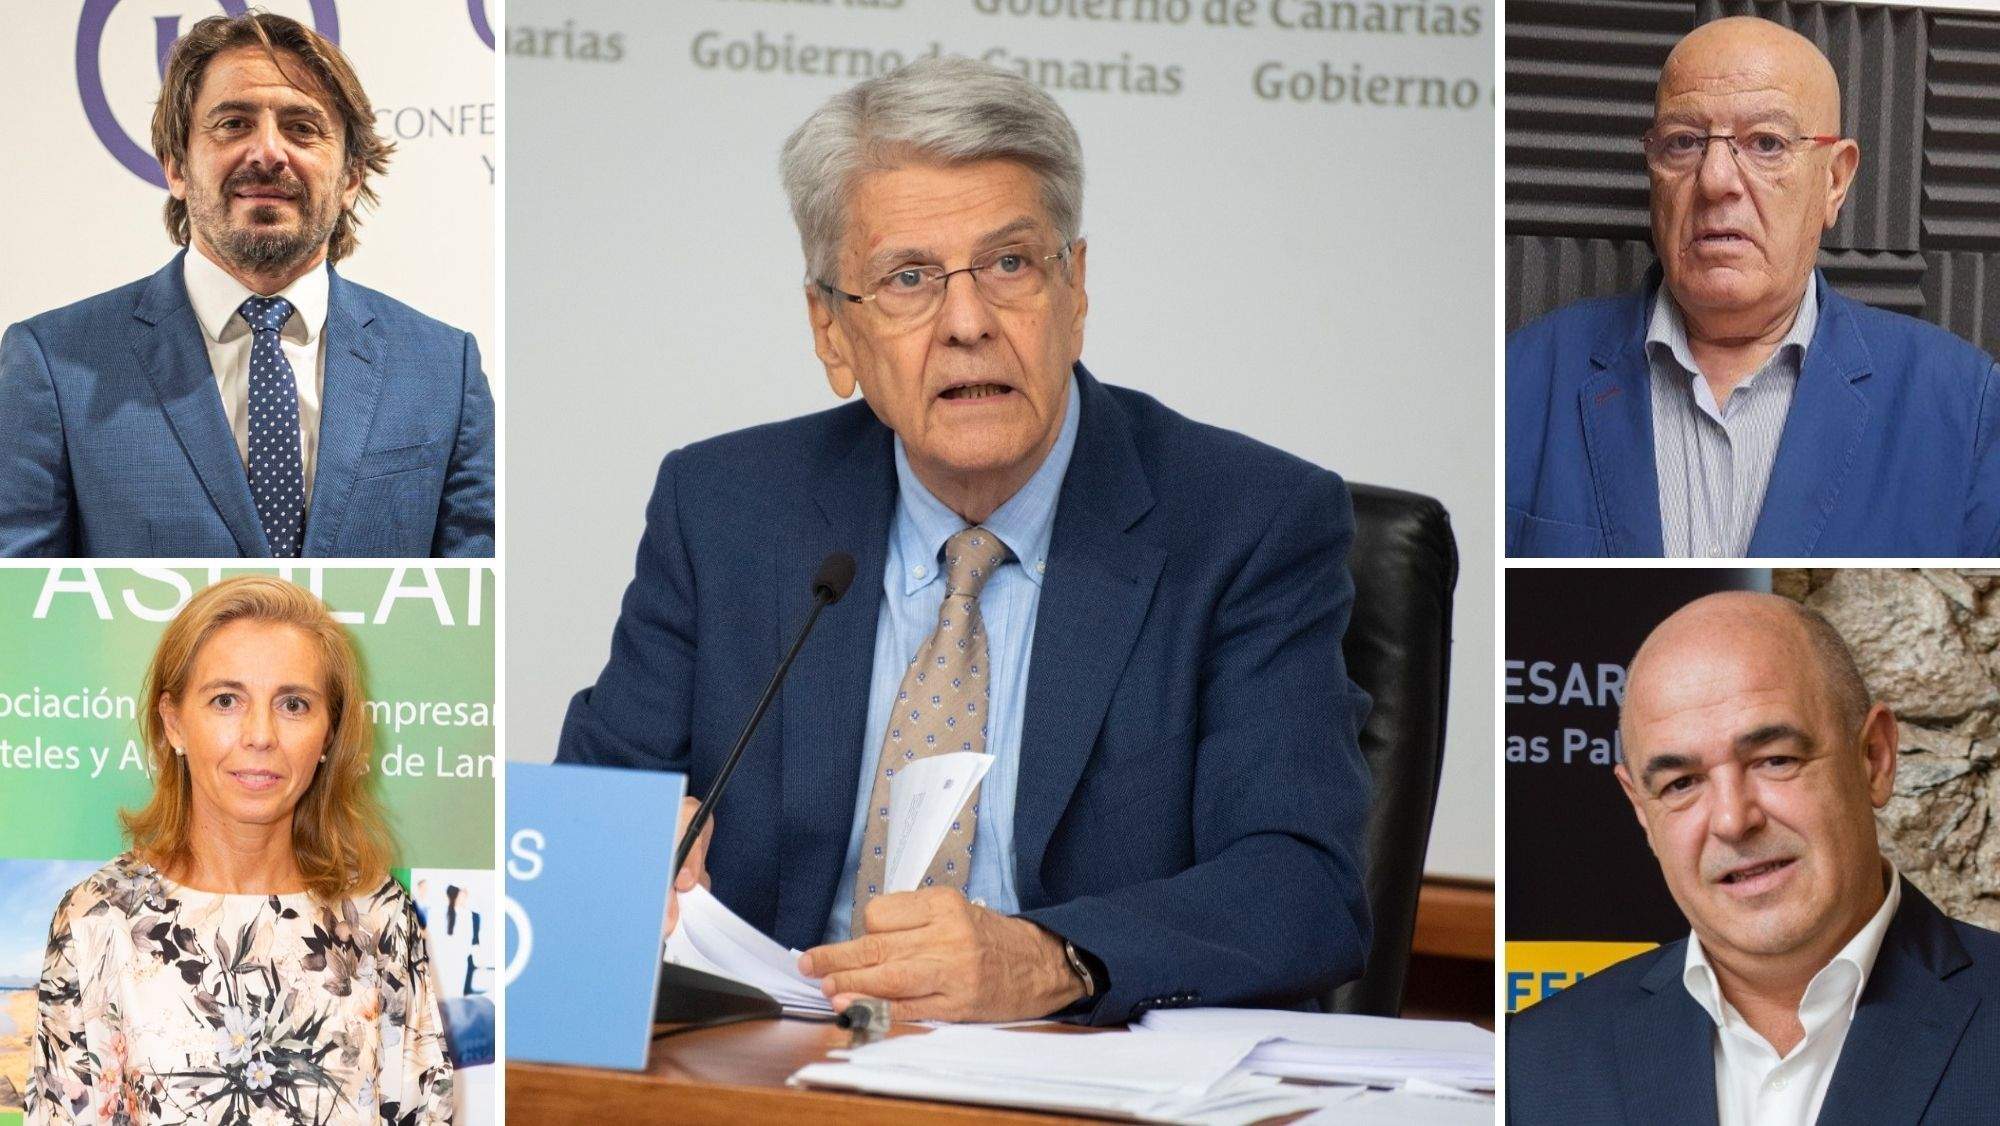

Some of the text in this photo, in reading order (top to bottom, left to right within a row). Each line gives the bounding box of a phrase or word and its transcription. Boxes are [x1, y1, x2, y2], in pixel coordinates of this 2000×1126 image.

[1202, 0, 1256, 27] de
[1269, 0, 1482, 36] Canarias
[505, 20, 626, 63] arias
[690, 31, 902, 79] Gobierno
[1252, 59, 1479, 110] Gobierno
[1505, 660, 1628, 706] ESAR
[363, 700, 495, 733] mpresa
[0, 736, 80, 770] teles
[89, 747, 110, 779] y
[381, 744, 425, 777] de
[1506, 735, 1550, 763] as
[1507, 971, 1585, 1011] FE
